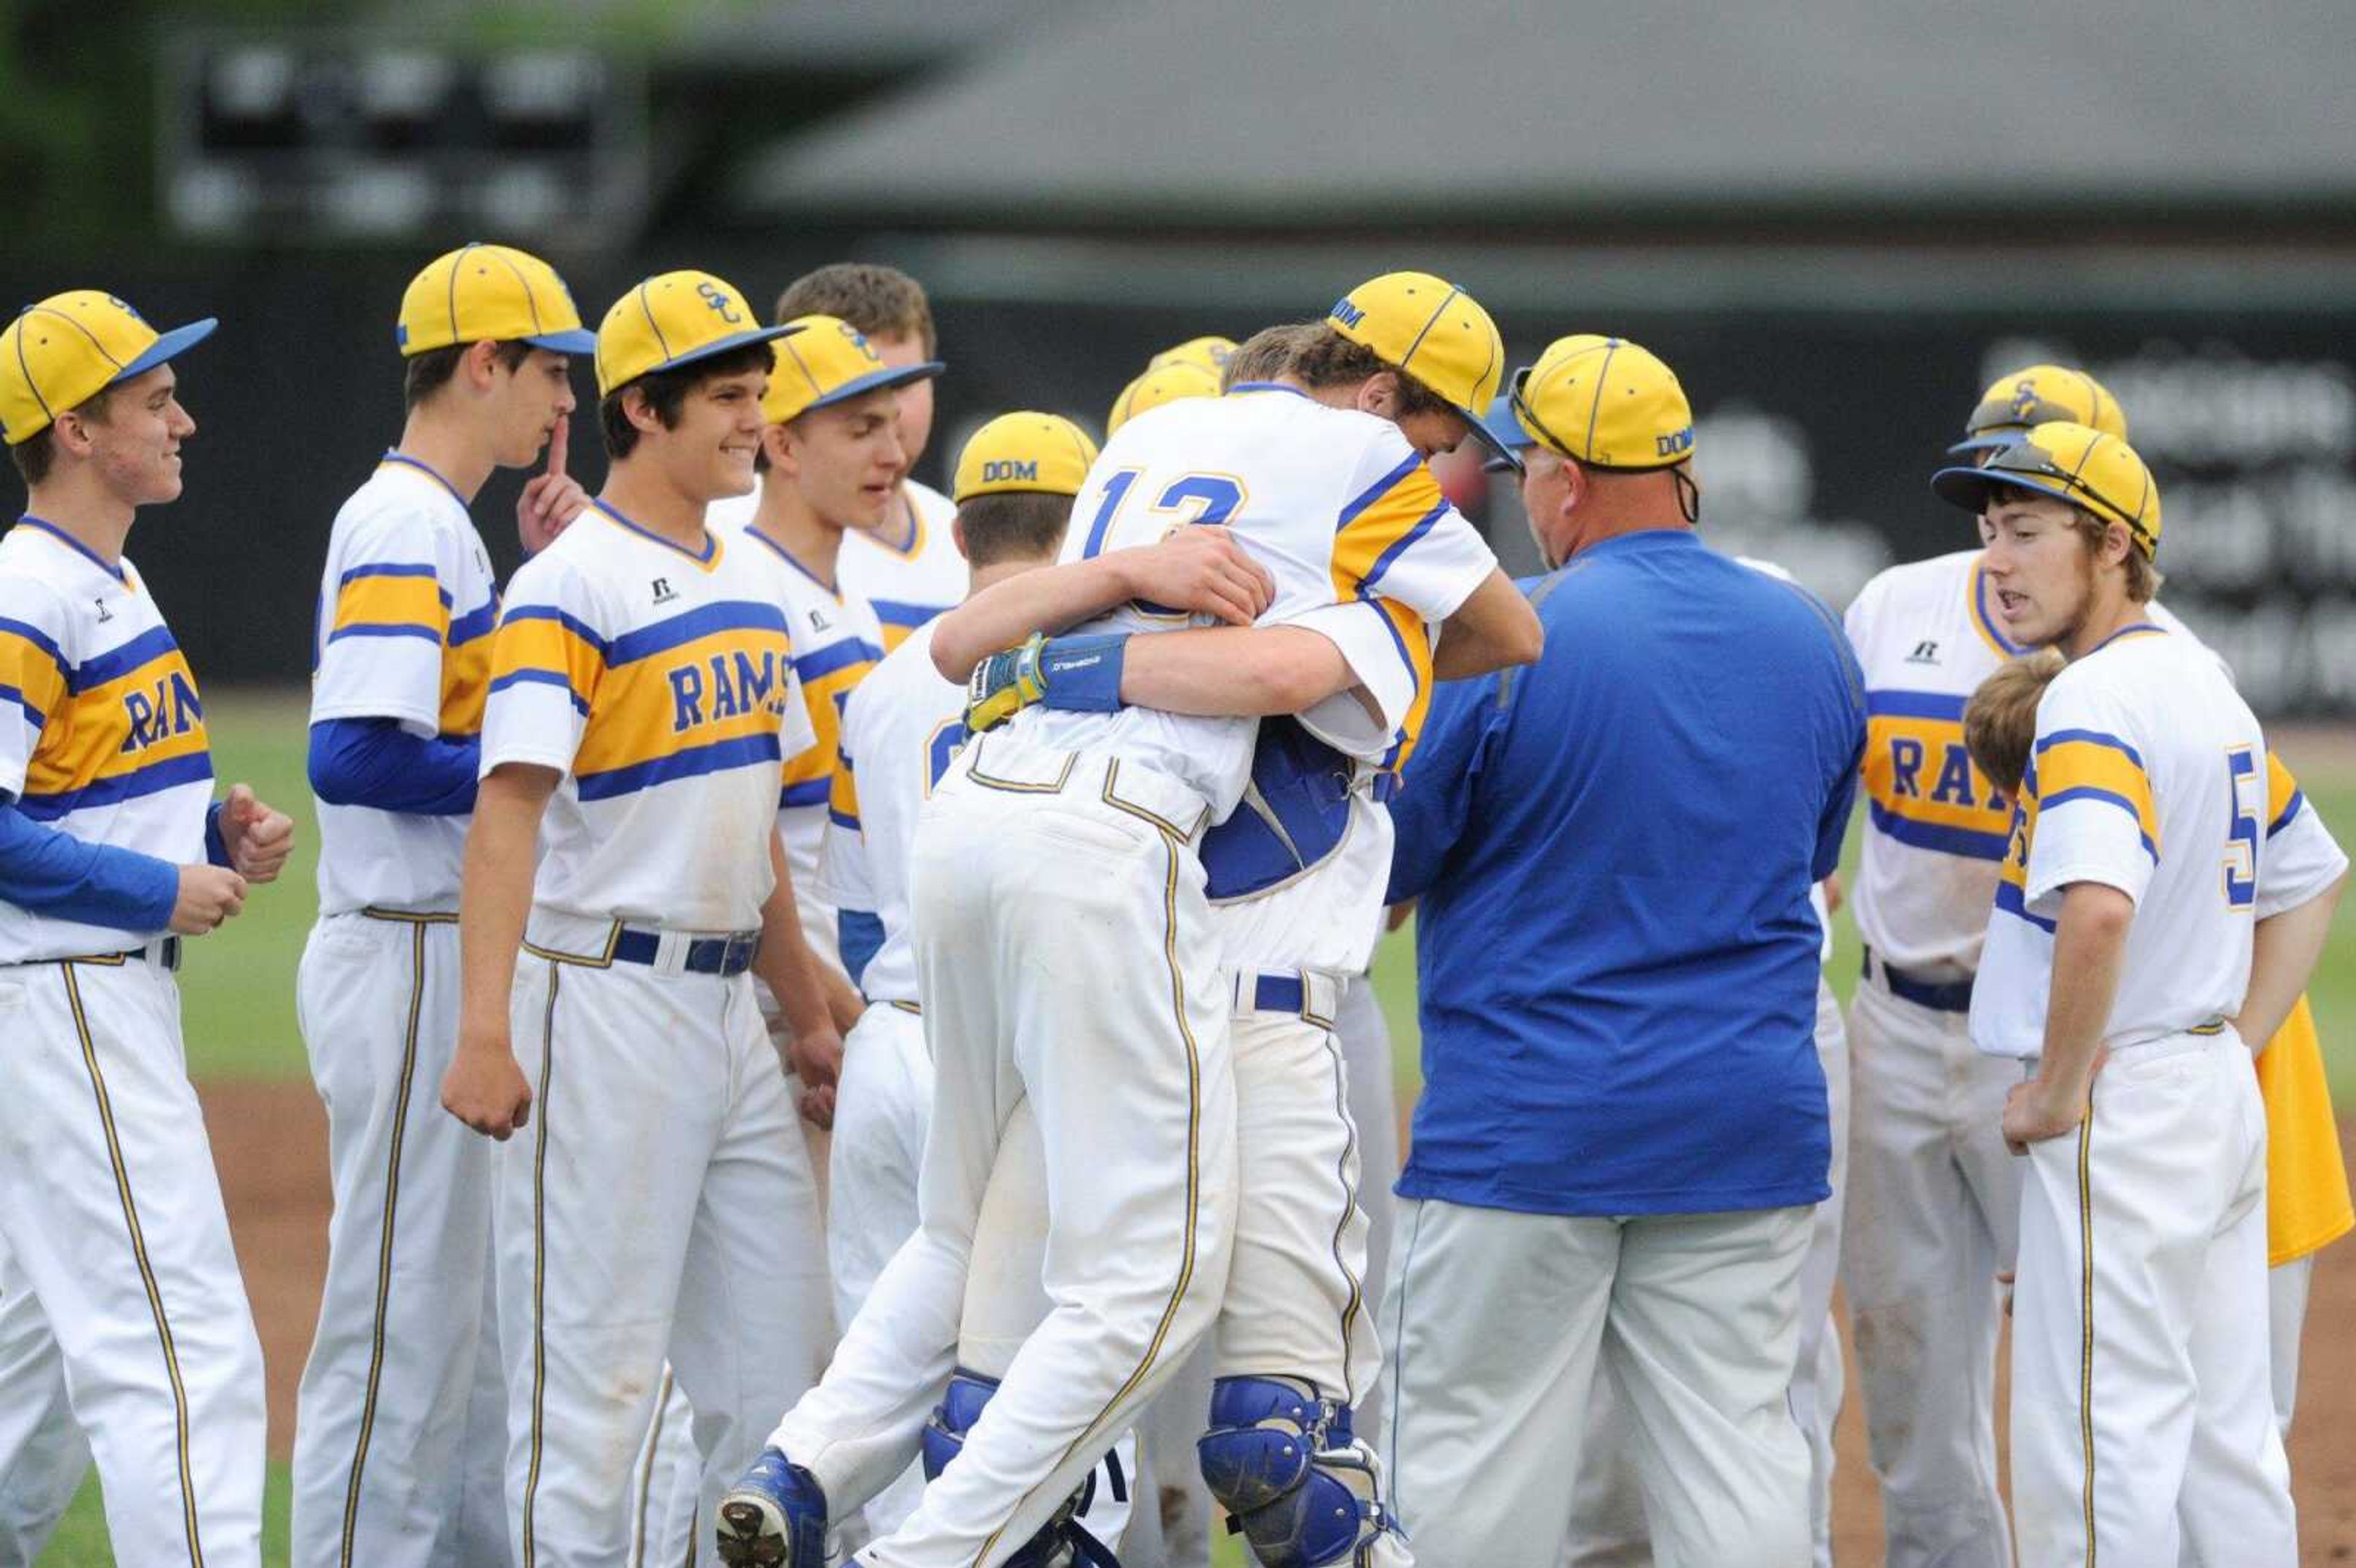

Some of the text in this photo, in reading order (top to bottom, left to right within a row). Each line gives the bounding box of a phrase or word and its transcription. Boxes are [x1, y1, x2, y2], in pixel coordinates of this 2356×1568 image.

[697, 283, 741, 323] SC
[983, 460, 1037, 483] DOM
[1890, 737, 2006, 810] RA
[2222, 744, 2258, 912] 5
